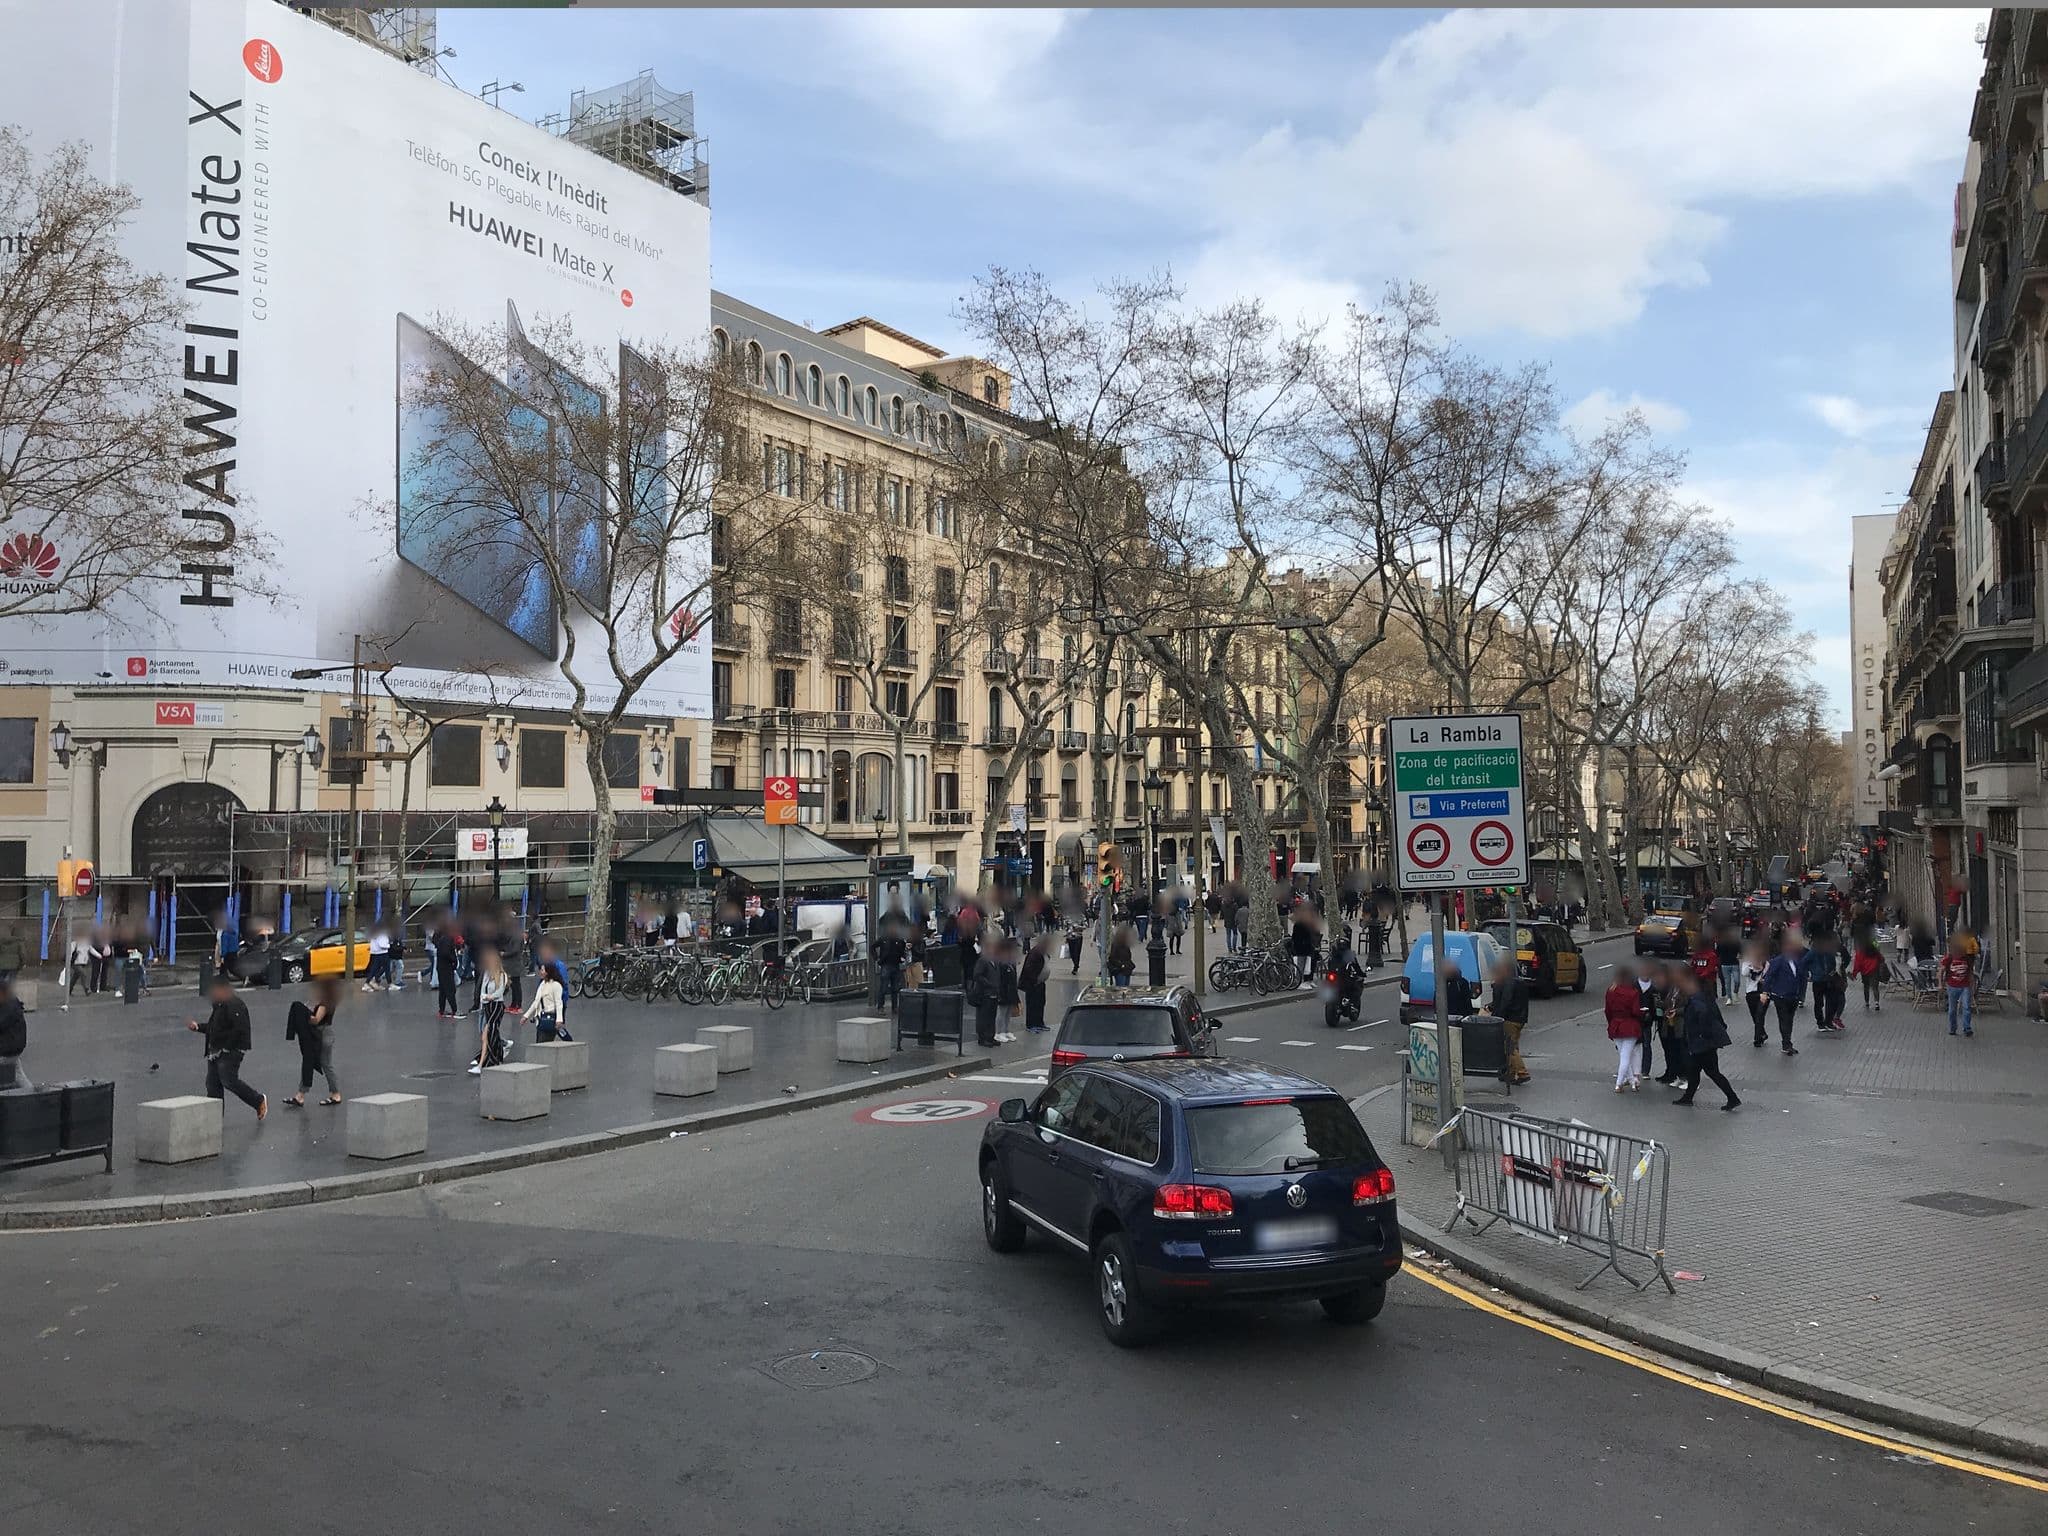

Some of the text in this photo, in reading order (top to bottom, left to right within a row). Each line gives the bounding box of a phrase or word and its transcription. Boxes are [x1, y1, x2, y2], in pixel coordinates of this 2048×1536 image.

[254, 44, 270, 81] Leica
[478, 141, 541, 187] Coneix
[406, 140, 458, 177] Telèfon
[463, 165, 482, 186] 5G
[487, 175, 542, 213] Plegable
[546, 201, 572, 225] Més
[576, 213, 610, 240] Ràpid
[613, 229, 631, 249] del
[253, 103, 270, 321] CO-ENGINEERED WITH
[449, 201, 615, 285] HUAWEI Mate X
[180, 90, 242, 607] HUAWEI Mate X
[149, 660, 194, 669] Ajuntament
[160, 667, 200, 675] Barcelona
[228, 663, 278, 677] HUAWEI
[372, 676, 428, 691] recuperació
[430, 680, 443, 691] de
[454, 682, 487, 696] mitgera
[590, 694, 609, 706] plaça
[649, 700, 667, 711] març
[160, 706, 191, 718] VSA
[1863, 643, 1878, 796] HOTEL ROYAL
[1410, 725, 1502, 743] La Rambla
[1399, 753, 1516, 770] Zona de pacificació
[1426, 772, 1491, 786] del trànsit
[776, 784, 786, 792] M
[1440, 799, 1506, 811] Via Preferent
[697, 844, 704, 856] P
[889, 1103, 973, 1118] 30
